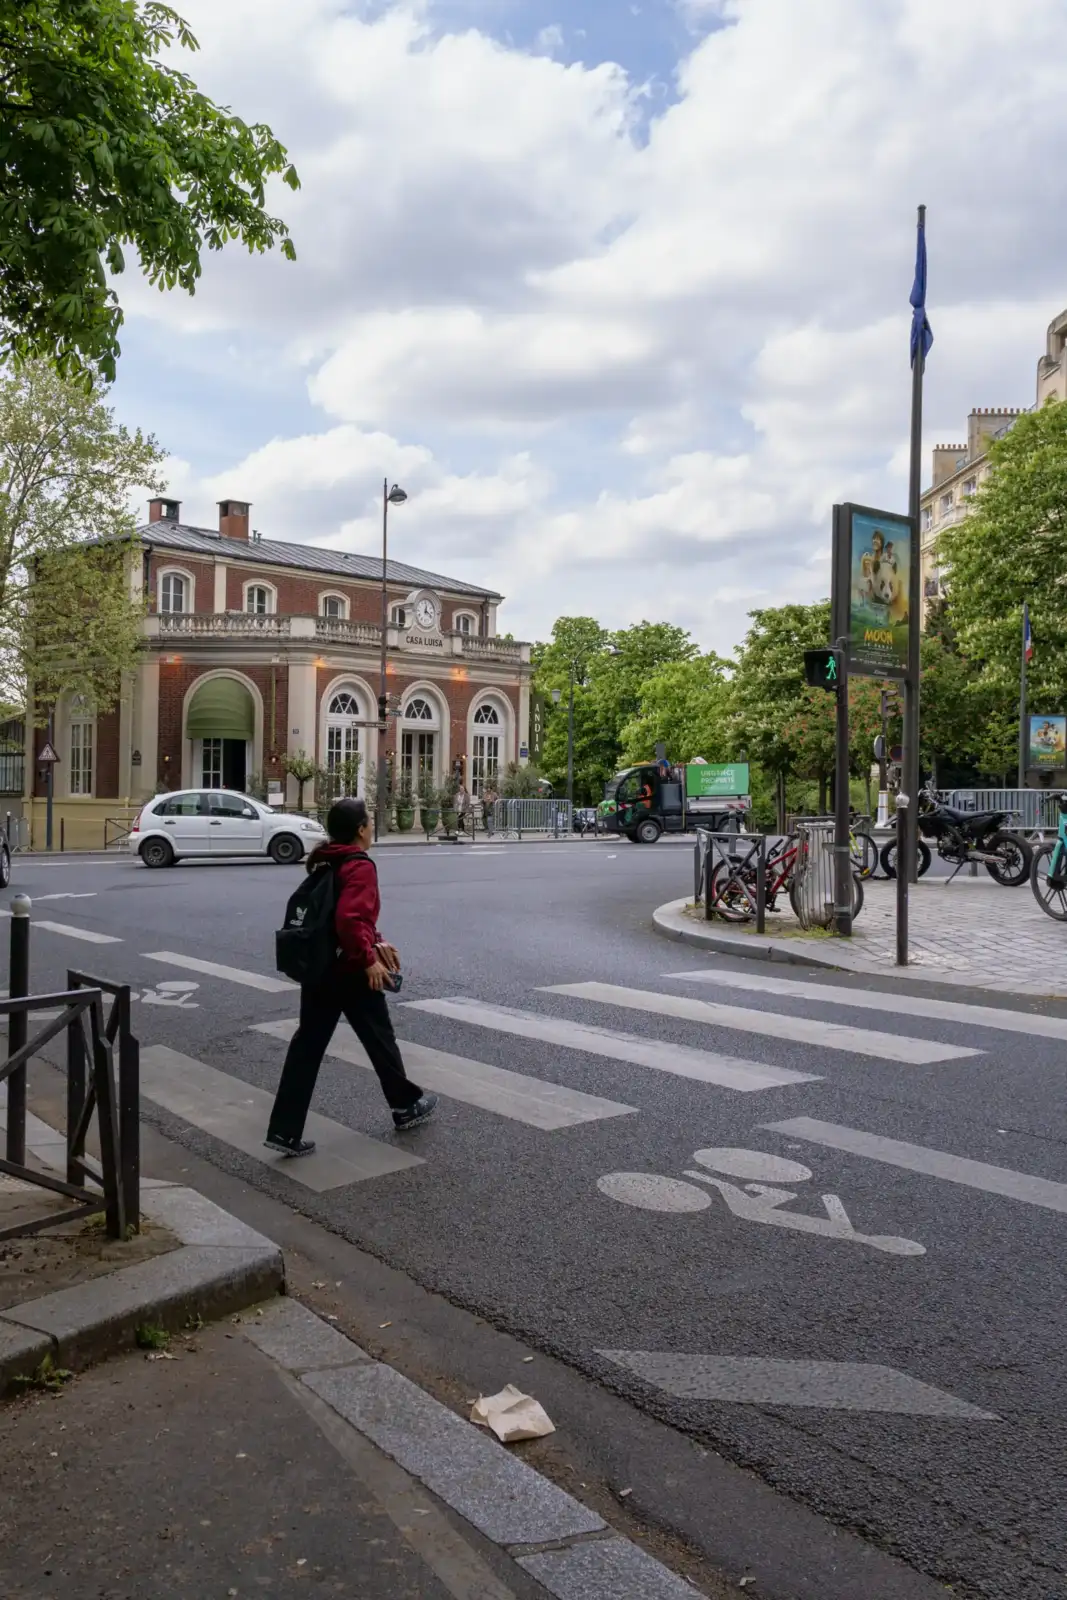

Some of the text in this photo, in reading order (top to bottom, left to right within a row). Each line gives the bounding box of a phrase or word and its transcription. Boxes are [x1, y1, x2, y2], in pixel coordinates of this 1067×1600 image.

[406, 635, 443, 647] CASA LUISA
[864, 628, 893, 645] MOON
